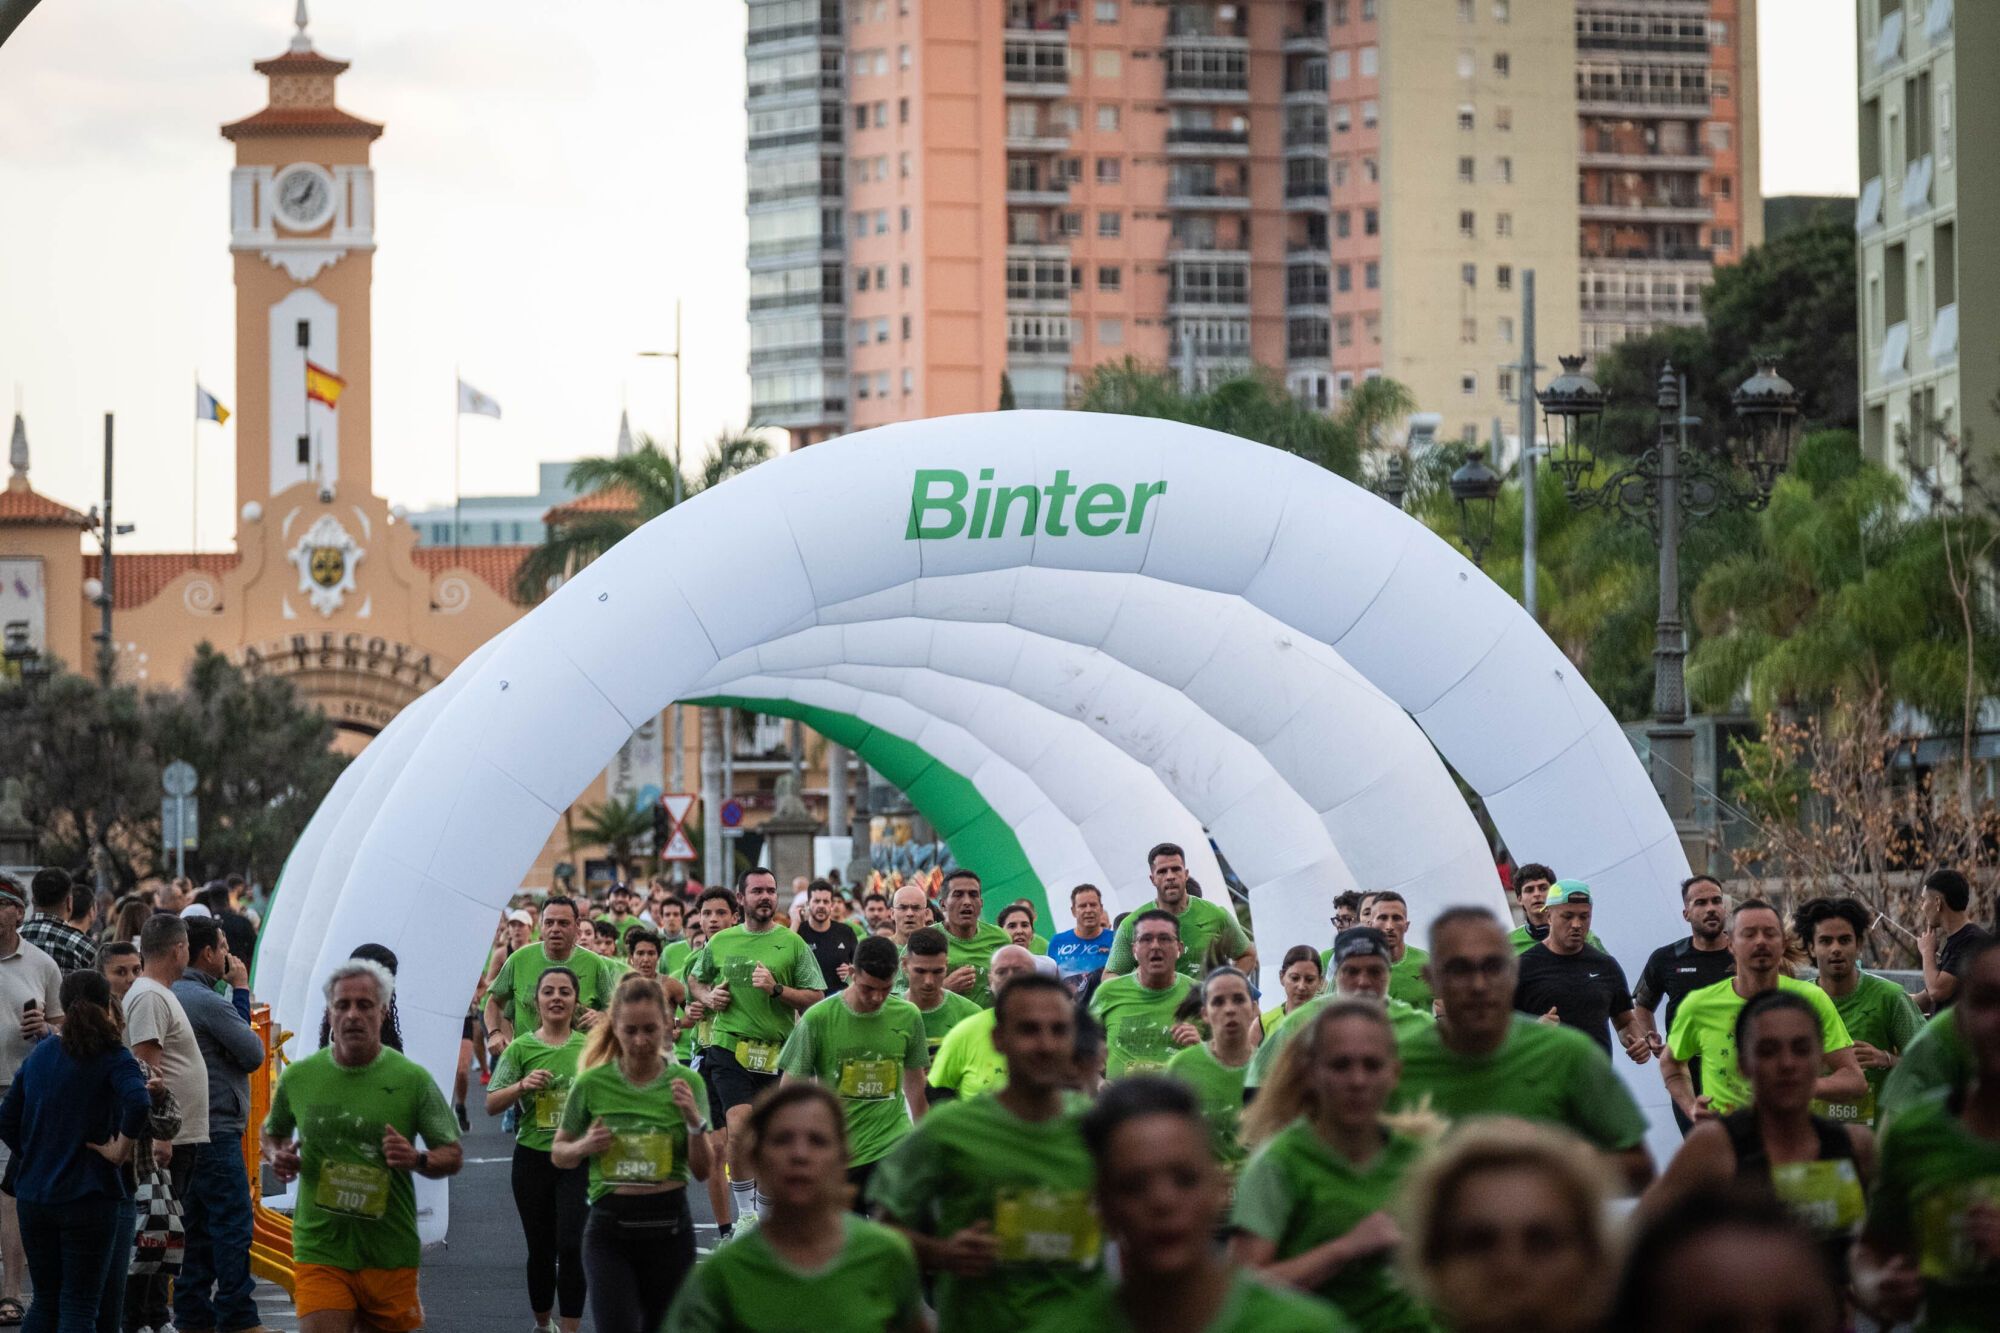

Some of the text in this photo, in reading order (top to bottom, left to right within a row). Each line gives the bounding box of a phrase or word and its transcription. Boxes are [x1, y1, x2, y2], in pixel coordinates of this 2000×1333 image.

[905, 468, 1168, 540] Binter
[748, 1055, 768, 1069] 7157
[857, 1081, 884, 1094] 5473
[1828, 1104, 1858, 1118] 8568
[336, 1190, 367, 1209] 7107
